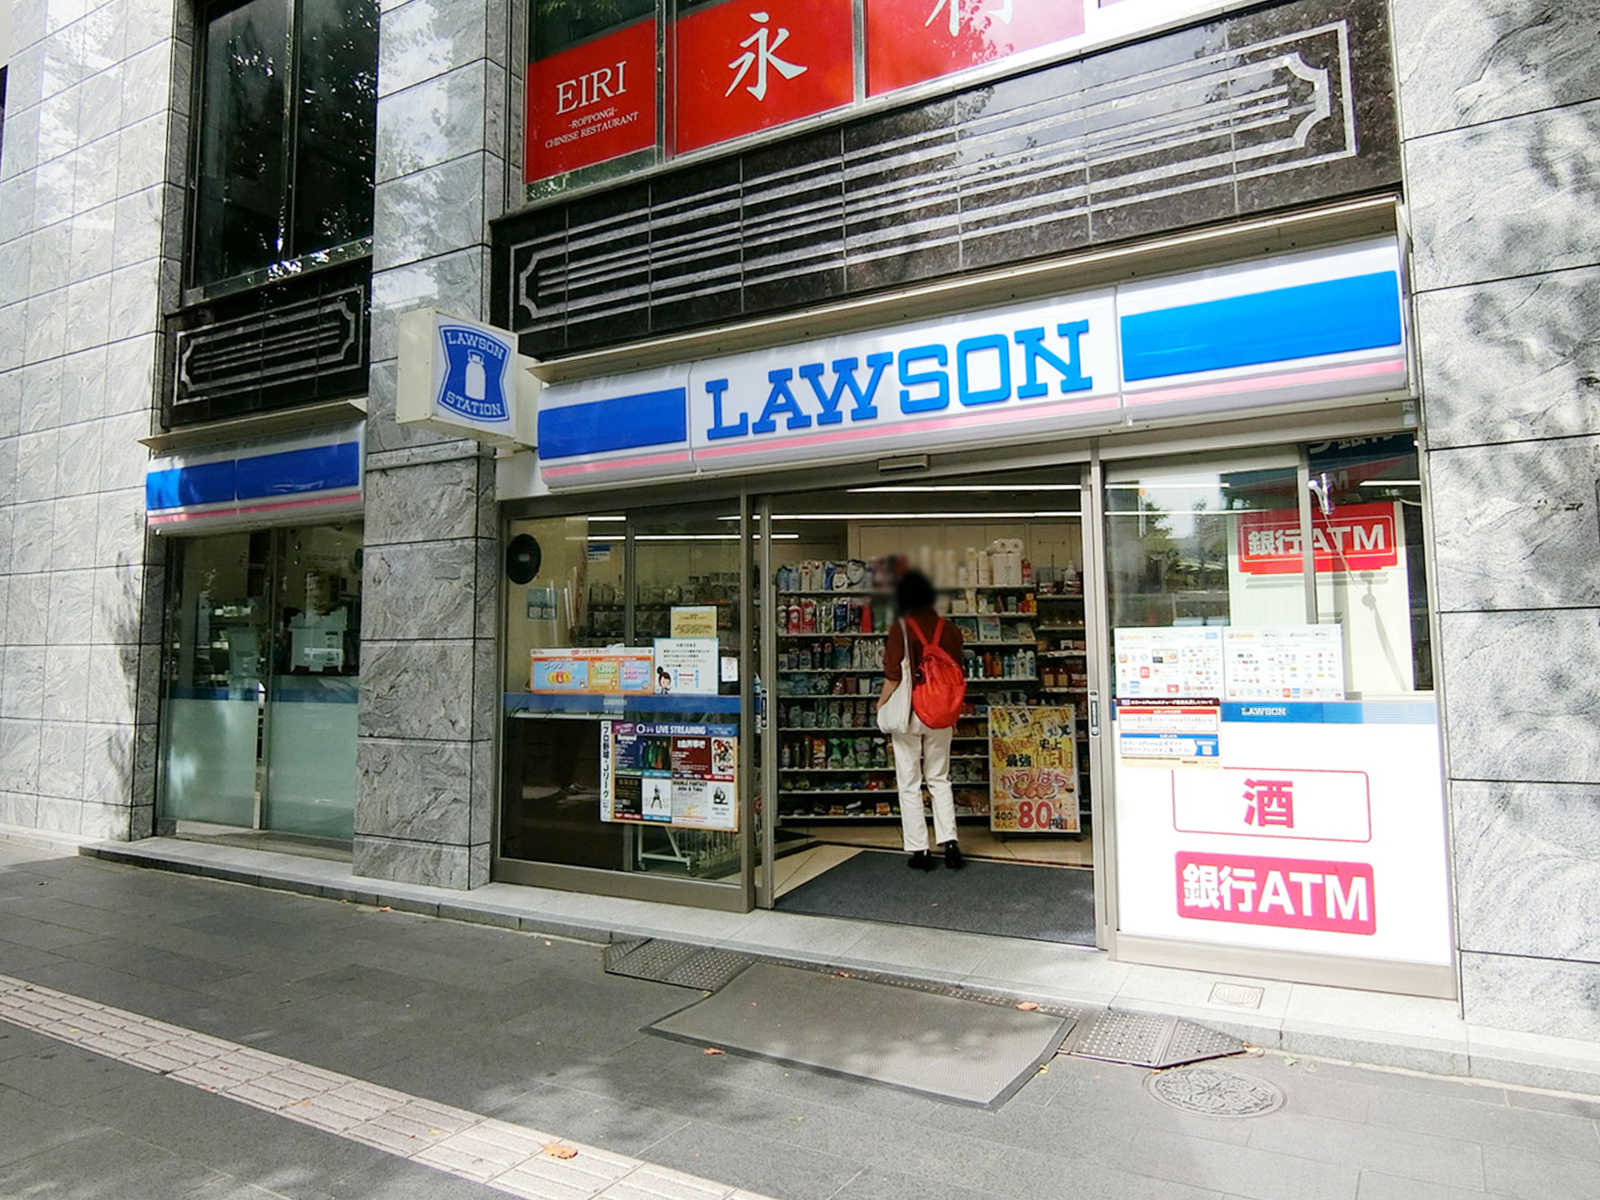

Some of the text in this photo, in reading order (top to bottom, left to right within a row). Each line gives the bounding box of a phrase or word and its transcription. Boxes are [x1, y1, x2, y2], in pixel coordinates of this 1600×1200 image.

[725, 12, 808, 101] 永
[556, 61, 627, 115] EIRI
[545, 111, 639, 149] CHINESE RESTAURANT
[446, 332, 505, 360] LAWSON
[706, 319, 1093, 440] LAWSON
[446, 391, 502, 415] STATION
[1248, 524, 1386, 557] 銀行ATM
[1241, 707, 1286, 717] LAWSON
[1242, 778, 1294, 828] 酒
[1182, 863, 1369, 922] 銀行ATM
